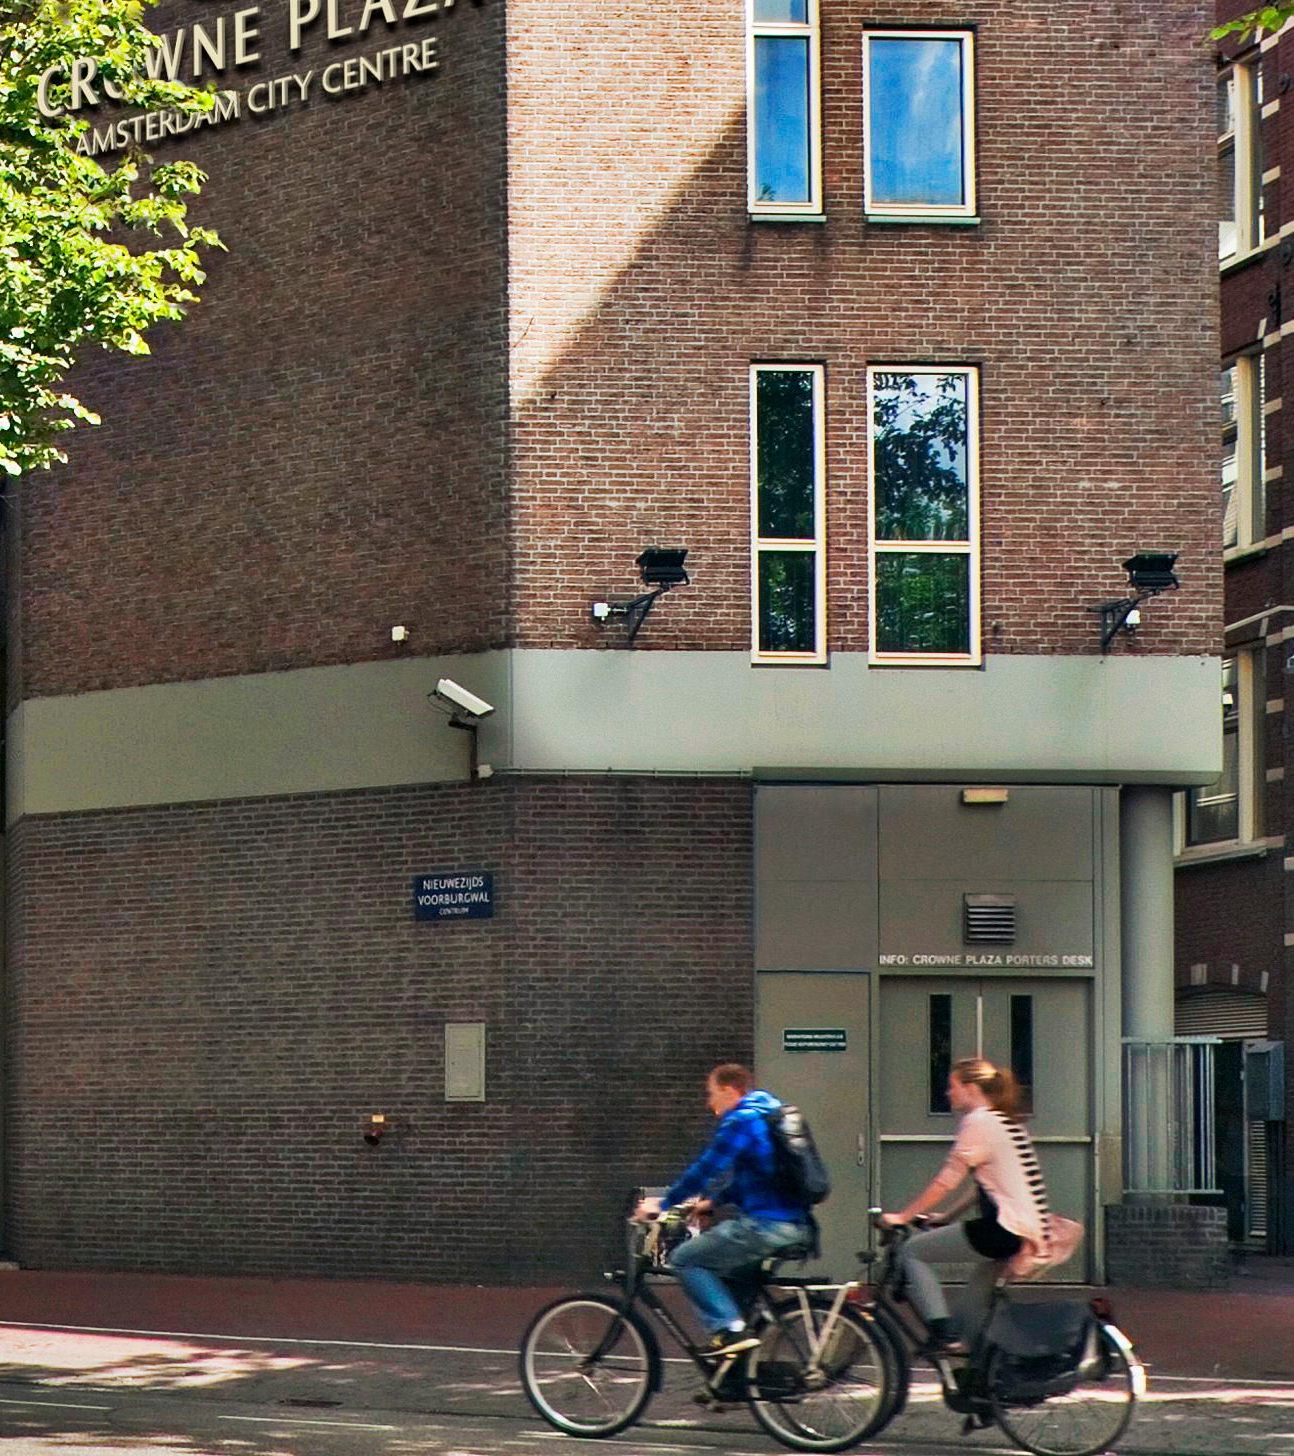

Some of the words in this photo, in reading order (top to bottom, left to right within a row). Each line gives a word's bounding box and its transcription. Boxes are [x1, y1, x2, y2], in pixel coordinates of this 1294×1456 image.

[75, 89, 241, 157] AMSTERDAM
[247, 70, 313, 113] CITY
[322, 37, 440, 93] CENTRE
[423, 876, 484, 890] NIEUWEZIJDS
[418, 892, 490, 906] VOORBURGWAL
[912, 954, 961, 965] CROWNE
[965, 955, 1002, 965] PLAZA
[1006, 955, 1059, 965] PORTERS
[1062, 955, 1093, 966] DESK
